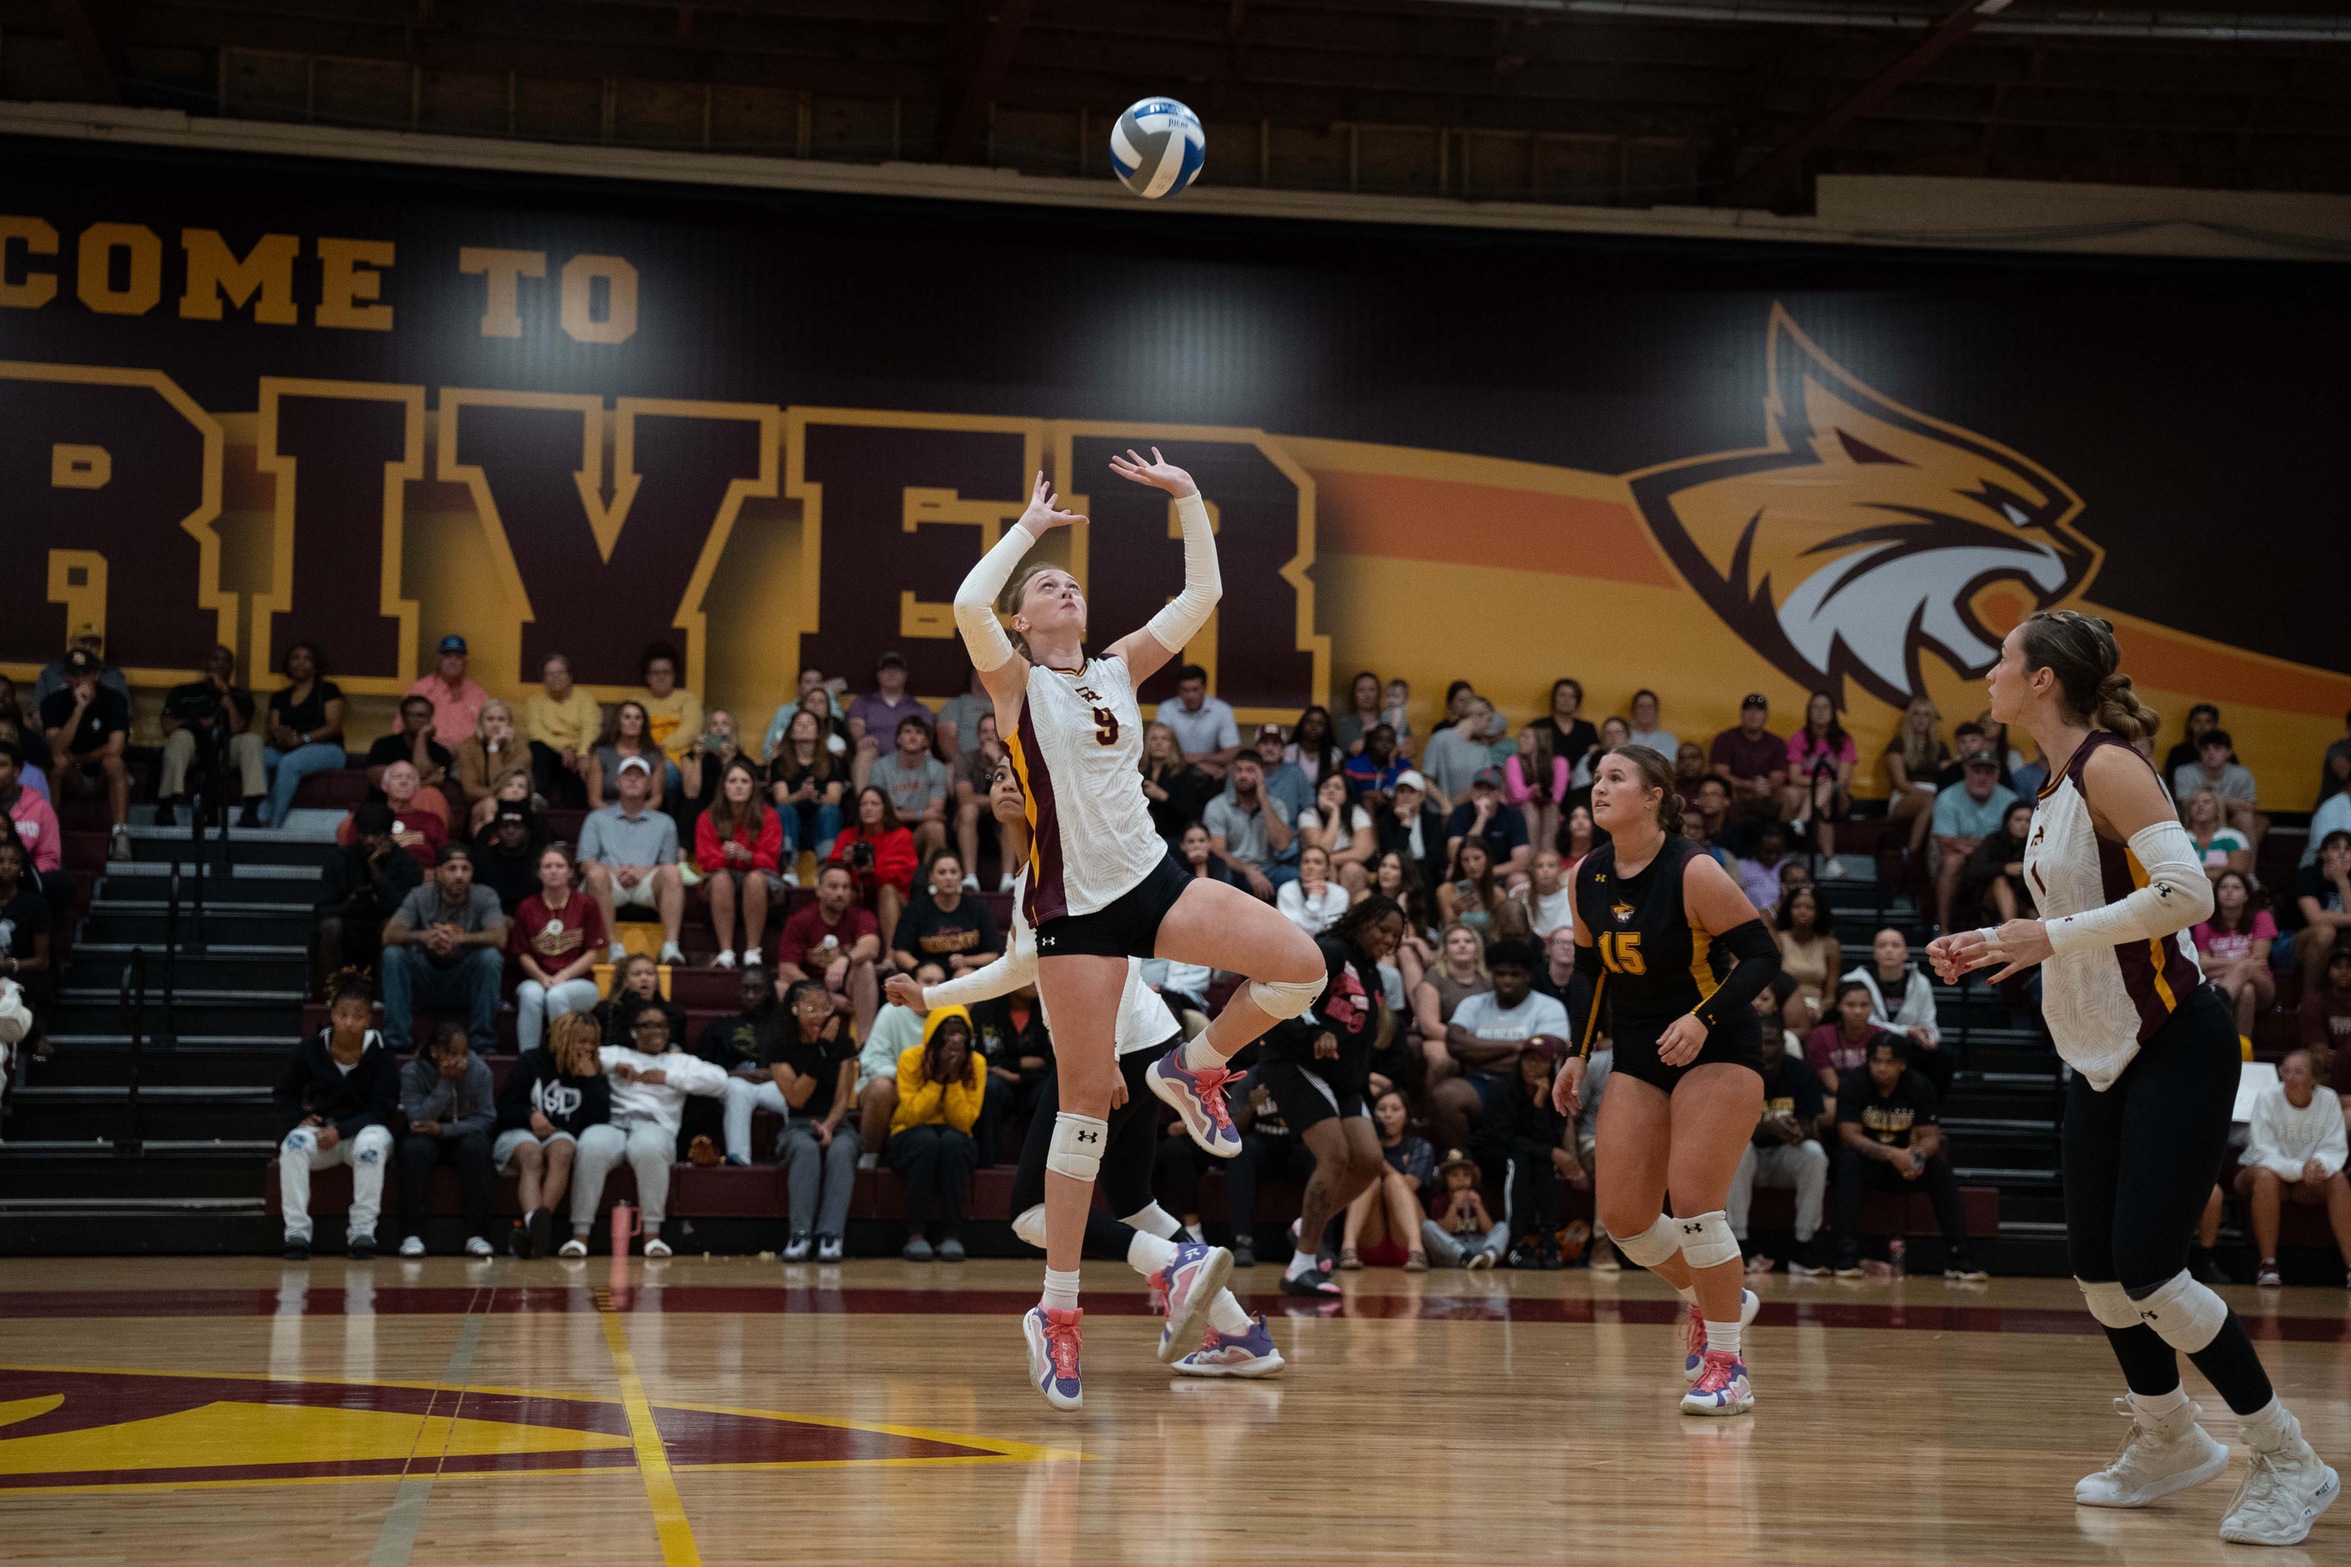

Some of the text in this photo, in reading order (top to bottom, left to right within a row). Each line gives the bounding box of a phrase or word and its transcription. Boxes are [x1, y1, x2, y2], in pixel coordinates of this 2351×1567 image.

[459, 247, 639, 344] TO
[0, 360, 1332, 724] RIVER
[1093, 707, 1119, 746] 9
[1598, 931, 1647, 975] 15
